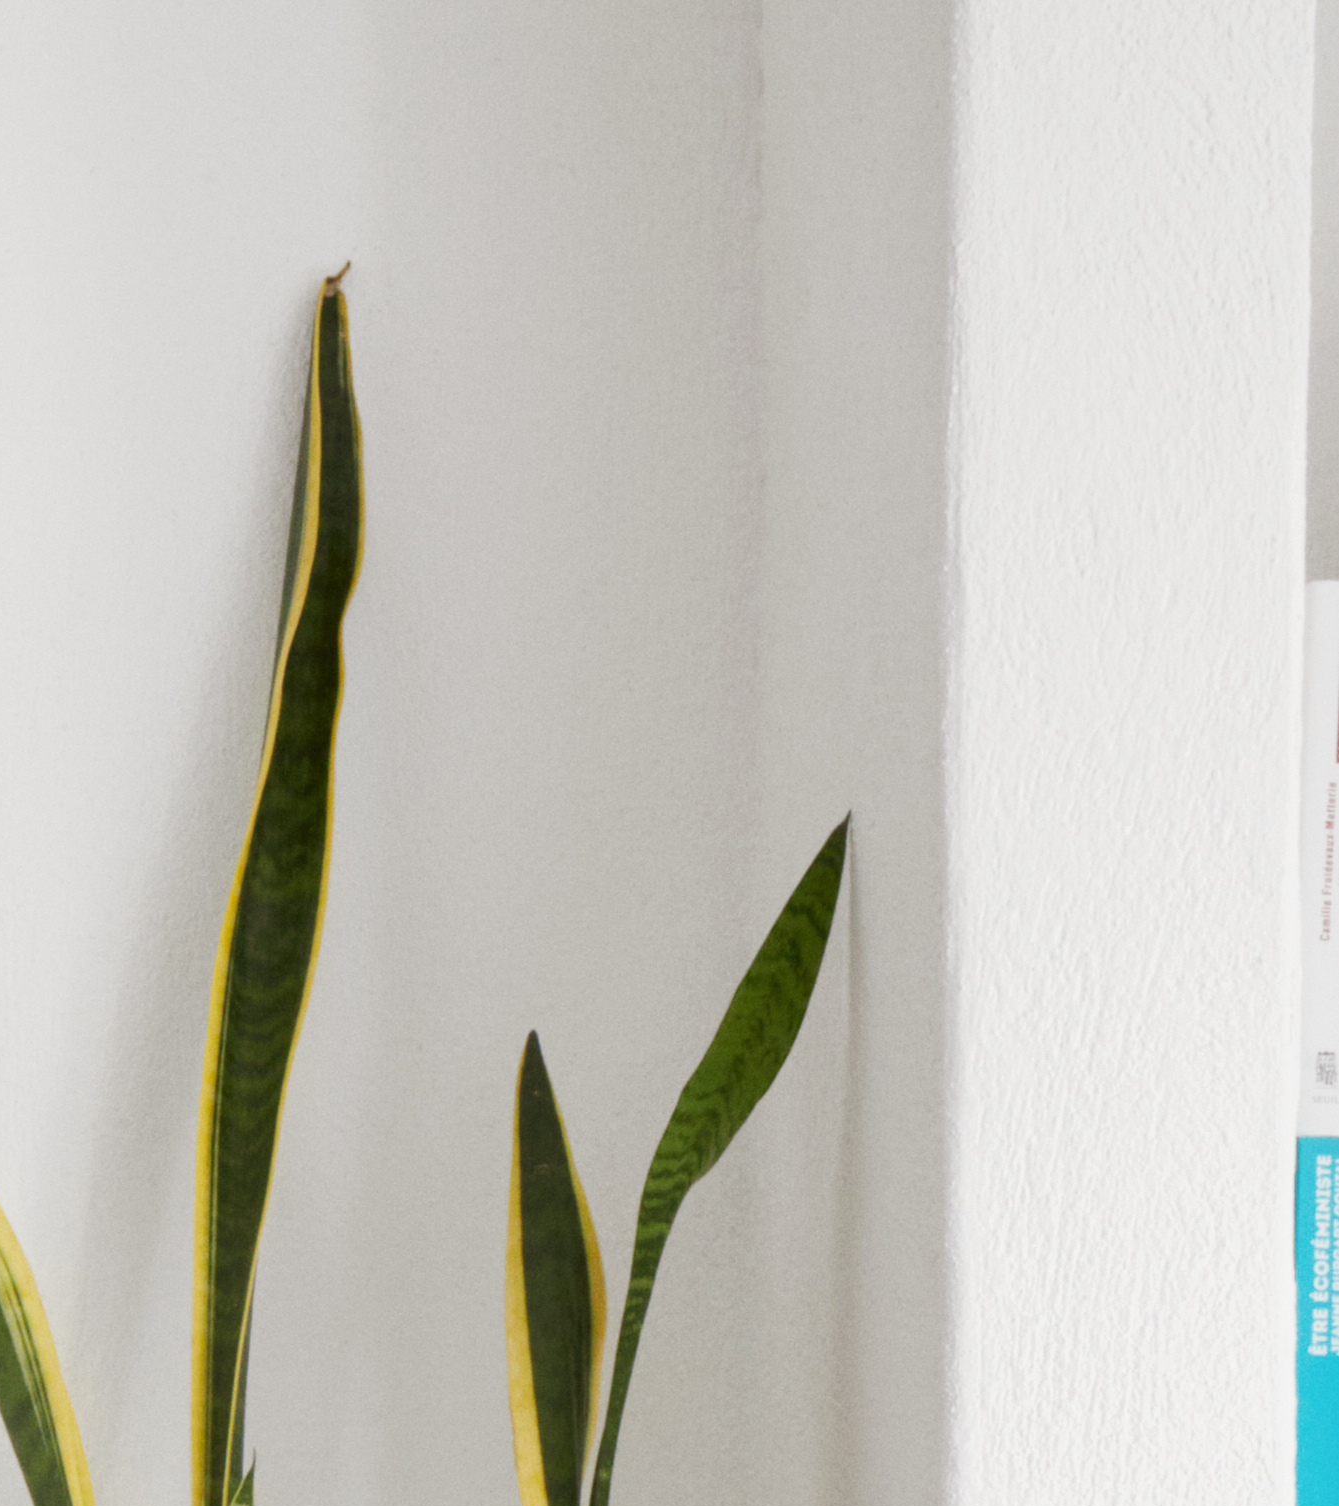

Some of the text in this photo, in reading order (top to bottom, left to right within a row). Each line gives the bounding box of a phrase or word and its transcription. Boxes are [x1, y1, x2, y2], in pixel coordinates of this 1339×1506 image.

[1319, 900, 1332, 942] Camille
[1307, 1153, 1332, 1357] ÊTRE ÉCOFÉMINISTE
